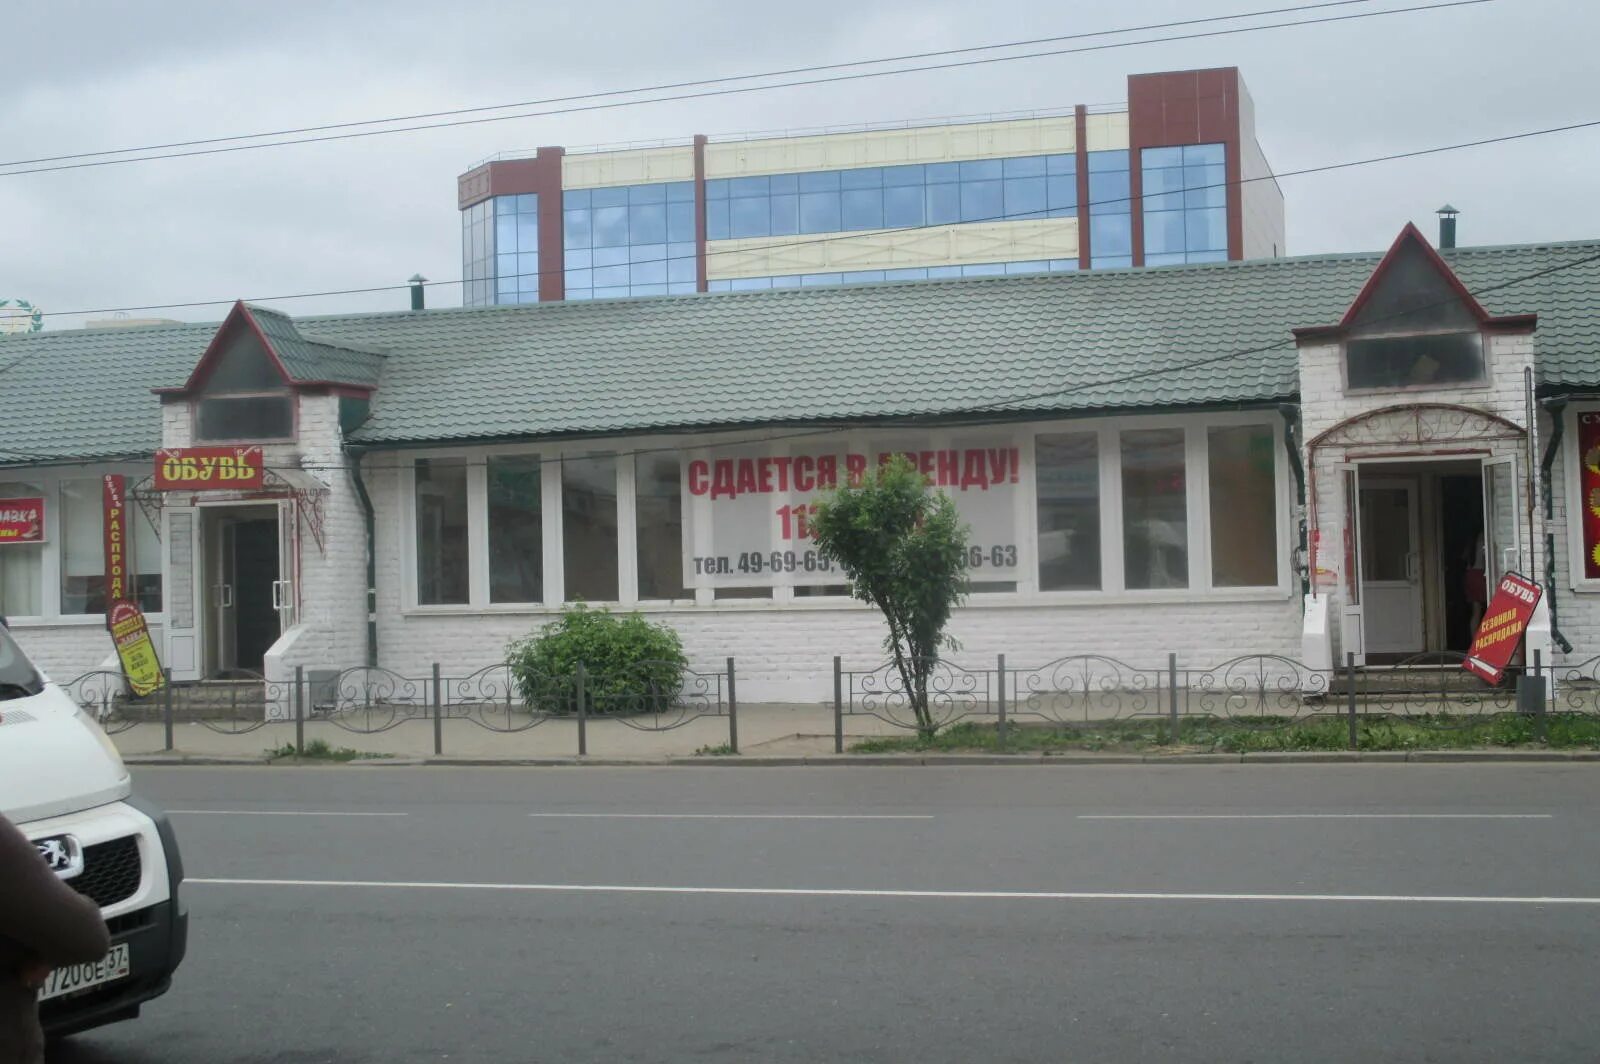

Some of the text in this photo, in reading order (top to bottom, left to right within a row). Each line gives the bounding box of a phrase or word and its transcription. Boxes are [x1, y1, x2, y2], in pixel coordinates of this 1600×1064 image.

[162, 455, 255, 481] ОБУВЬ
[688, 455, 837, 500] СДАЕТСЯ
[846, 453, 867, 489] В
[0, 508, 38, 523] АВКА
[775, 503, 822, 541] 11
[693, 556, 734, 575] тел.
[738, 549, 835, 574] 49-69-65,
[1501, 579, 1535, 604] ОБУВЬ
[1481, 607, 1517, 633] СЕЗОННАЯ
[1475, 620, 1522, 651] РАСПРОДАЖА
[109, 946, 123, 969] 37
